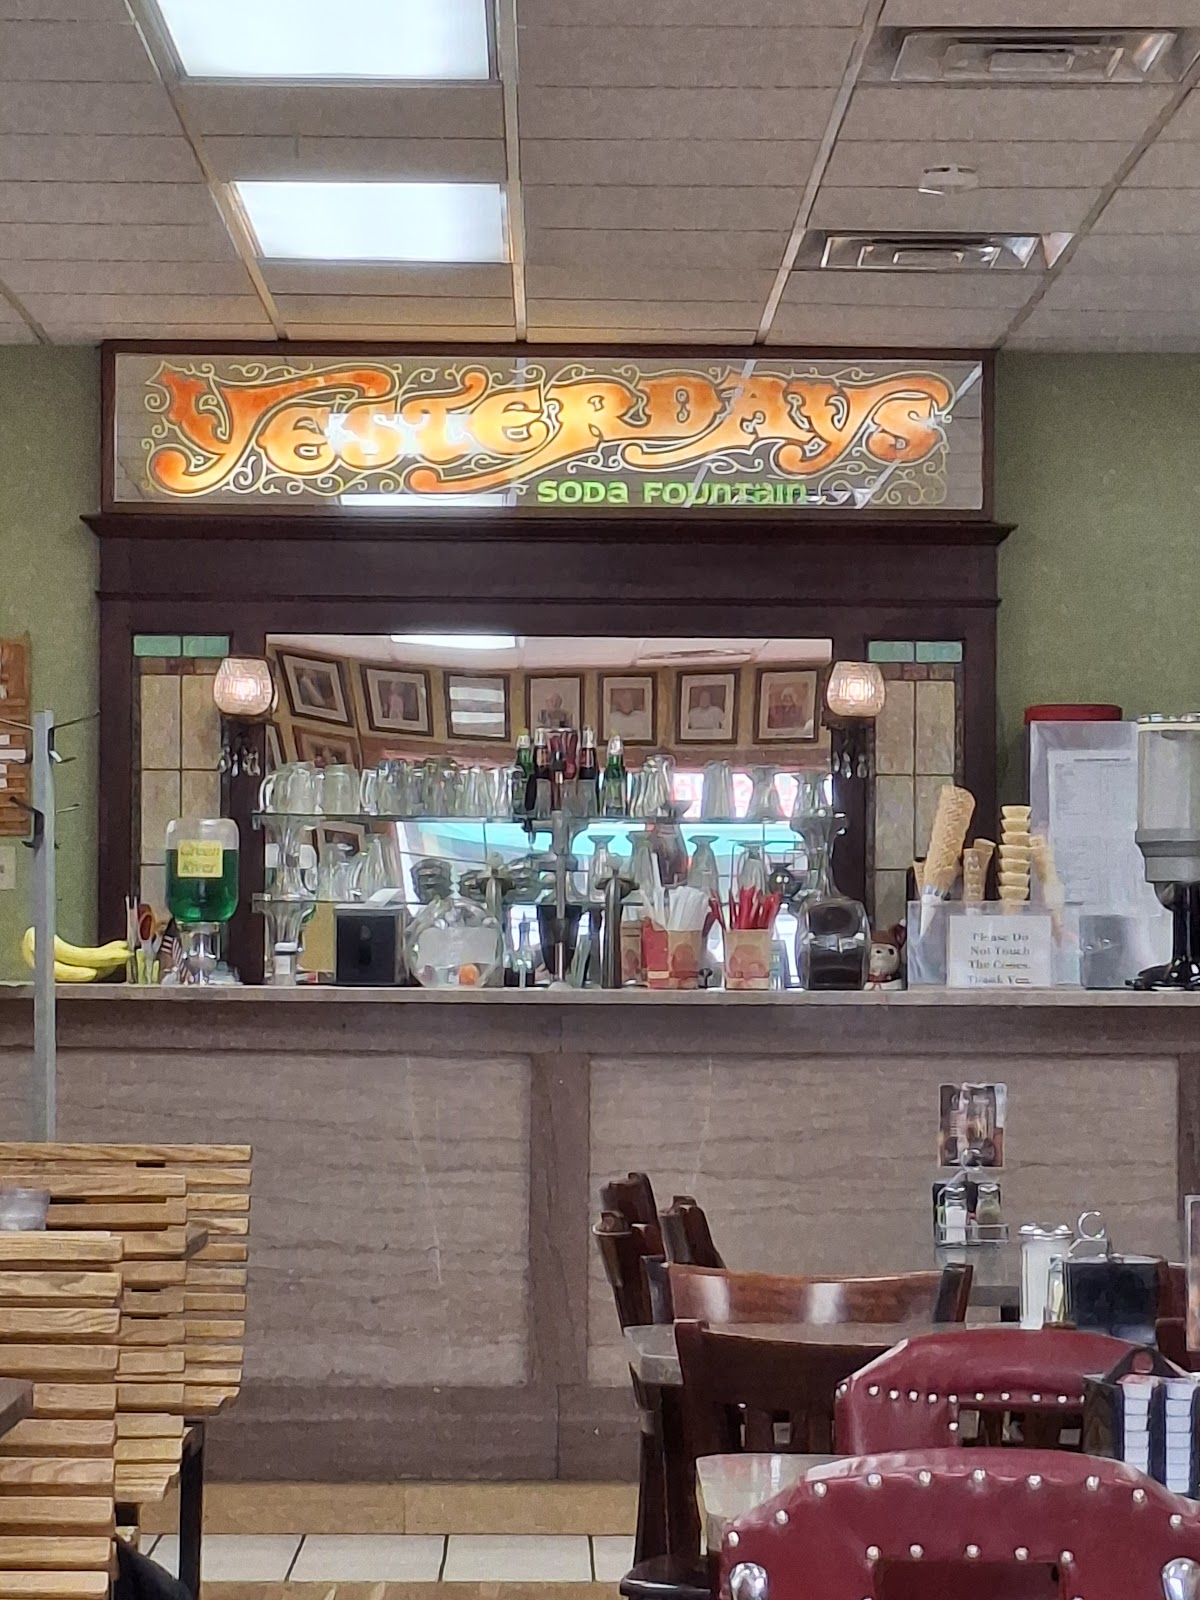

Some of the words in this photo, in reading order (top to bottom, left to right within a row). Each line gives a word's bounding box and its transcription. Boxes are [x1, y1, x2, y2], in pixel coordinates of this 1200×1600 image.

[1012, 933, 1030, 941] Do
[970, 946, 992, 955] Not
[994, 946, 1031, 956] Touch
[968, 960, 990, 970] The
